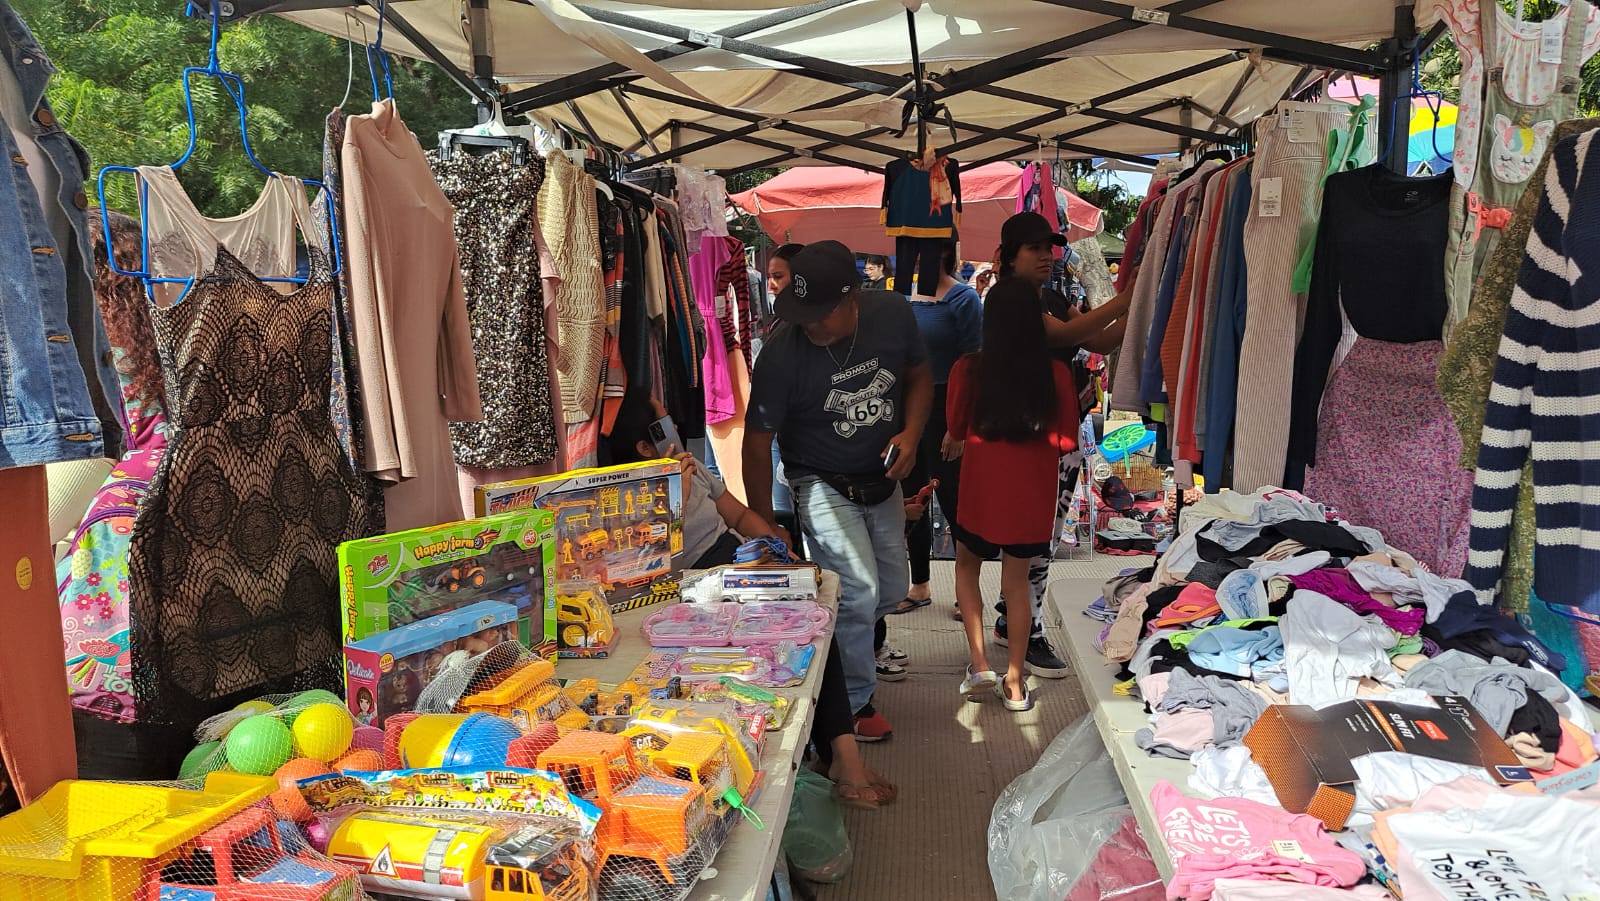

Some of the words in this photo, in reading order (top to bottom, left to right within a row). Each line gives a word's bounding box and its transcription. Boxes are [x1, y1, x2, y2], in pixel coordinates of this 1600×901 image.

[833, 360, 877, 382] PROMOTO
[850, 389, 875, 403] ROUTE
[855, 400, 879, 422] 66
[588, 476, 607, 484] SUPER
[608, 472, 629, 481] POWER
[414, 541, 449, 560] Happy
[450, 536, 475, 551] farm
[344, 564, 356, 609] Happy
[637, 735, 652, 750] CAT
[1190, 818, 1218, 844] BE
[1197, 805, 1251, 847] LET'S
[1464, 859, 1490, 869] &
